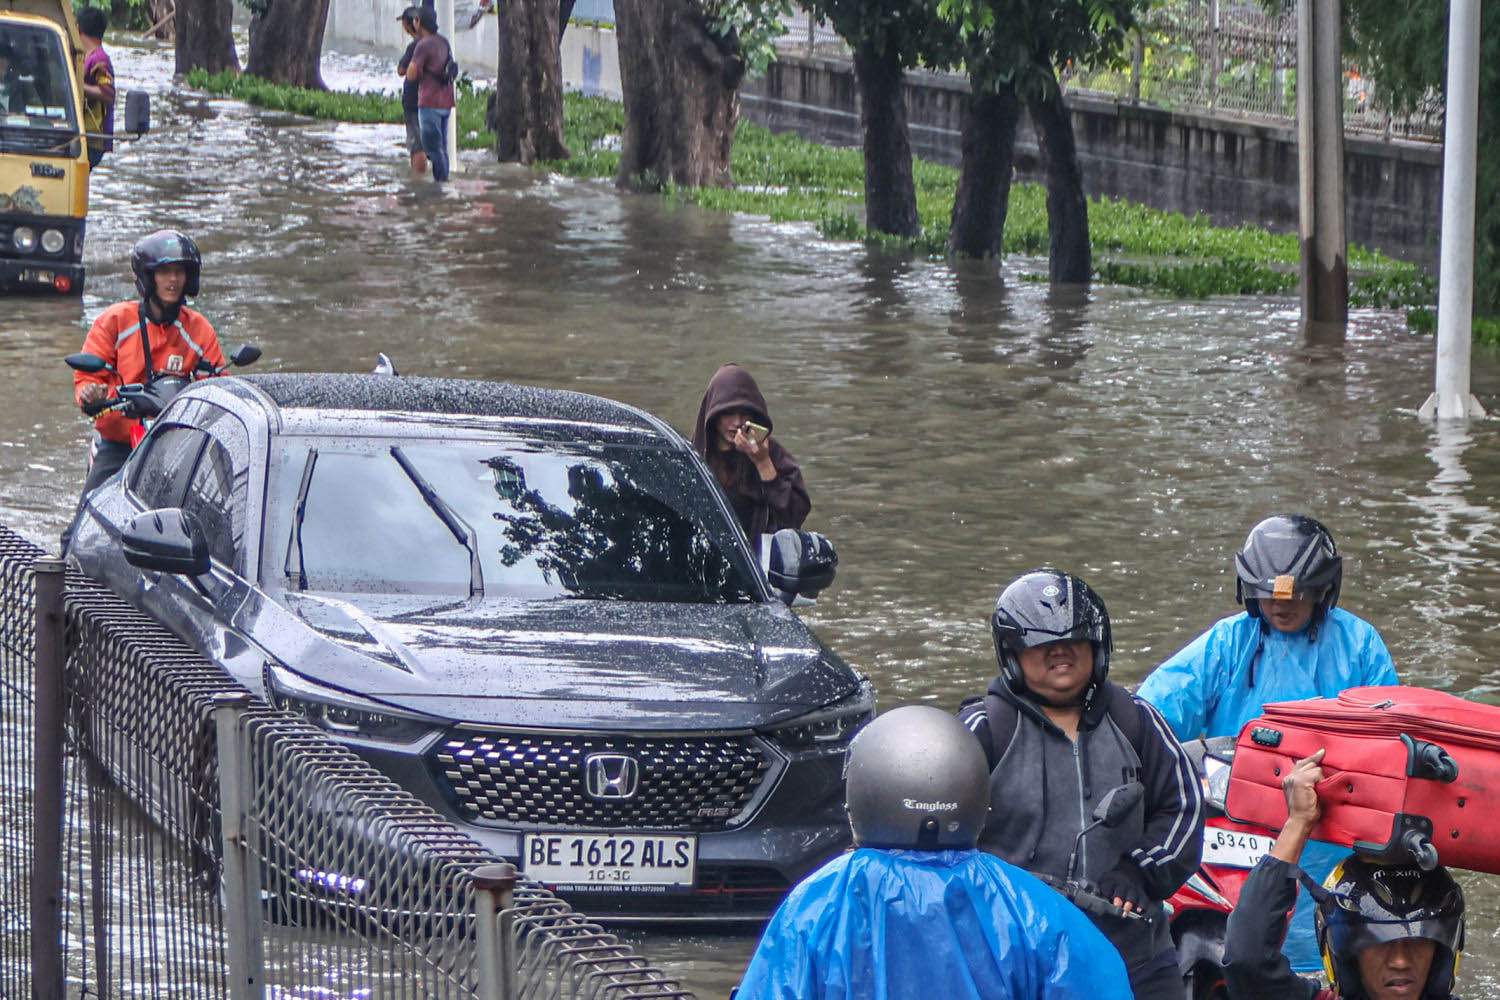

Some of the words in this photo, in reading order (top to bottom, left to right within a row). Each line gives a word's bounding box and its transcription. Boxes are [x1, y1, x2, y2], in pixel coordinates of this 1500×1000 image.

[1216, 831, 1258, 850] 6340
[530, 838, 562, 866] BE
[570, 839, 635, 867] 1612
[641, 839, 690, 868] ALS
